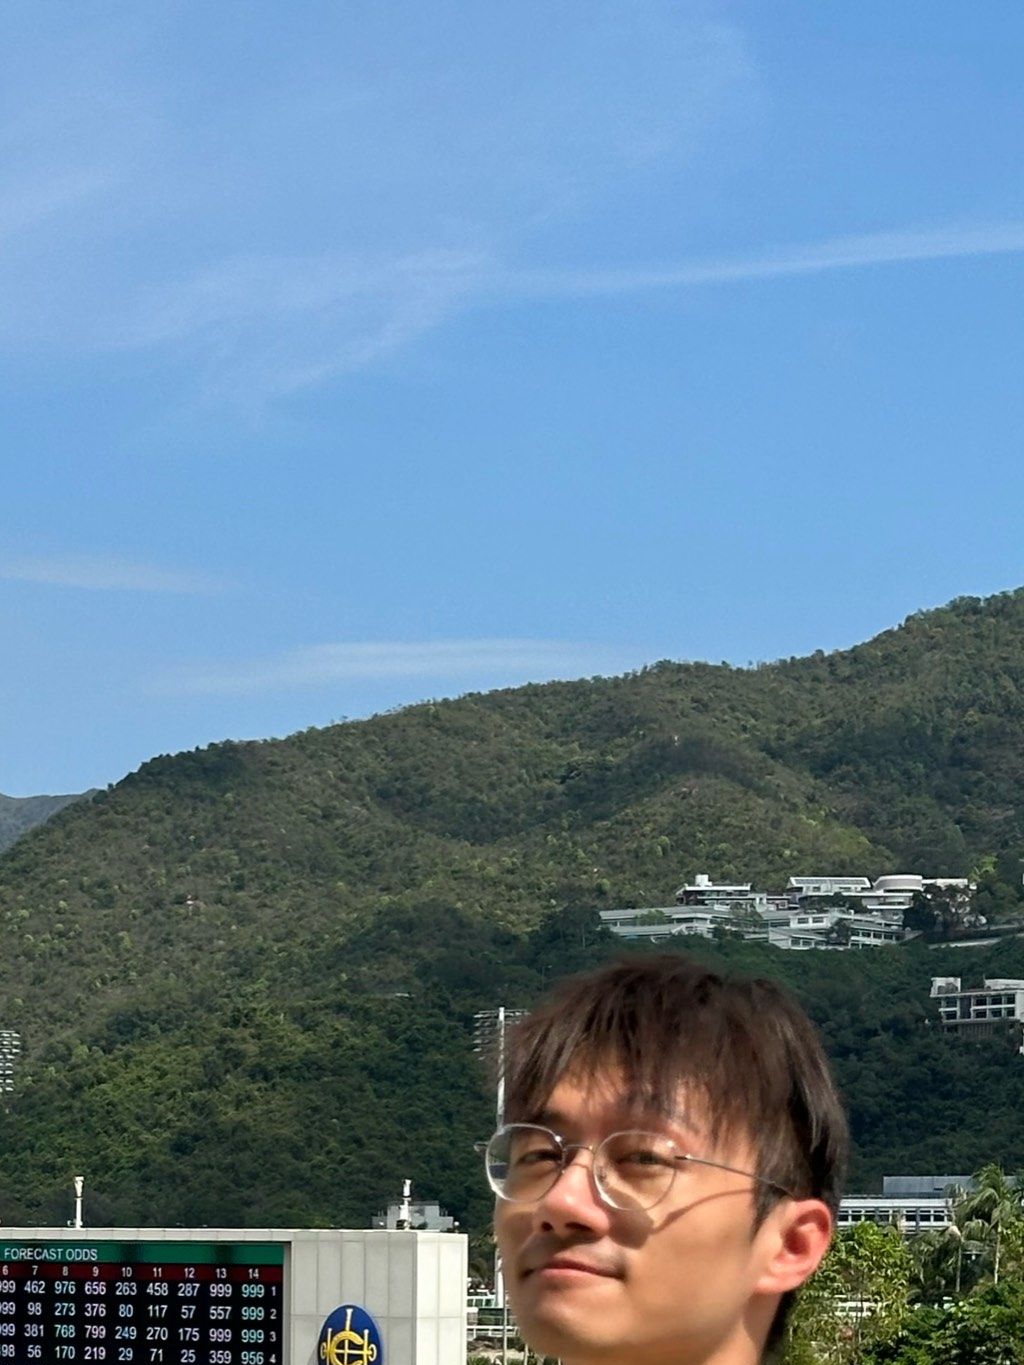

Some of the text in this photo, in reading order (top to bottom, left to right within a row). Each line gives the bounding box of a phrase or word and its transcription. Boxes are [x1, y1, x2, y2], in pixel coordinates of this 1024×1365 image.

[4, 1248, 64, 1260] FORECAST
[66, 1249, 98, 1260] ODDS
[2, 1265, 9, 1275] 6
[32, 1265, 38, 1275] 7
[62, 1266, 68, 1276] 8
[92, 1266, 99, 1277] 9
[122, 1267, 132, 1277] 10
[153, 1267, 162, 1277] 11
[184, 1267, 195, 1278] 12
[216, 1268, 227, 1279] 13
[248, 1268, 259, 1279] 14
[24, 1280, 45, 1294] 462
[54, 1281, 76, 1294] 976
[84, 1281, 106, 1295] 656
[115, 1282, 137, 1295] 263
[146, 1282, 169, 1296] 458
[177, 1283, 200, 1297] 287
[209, 1283, 232, 1297] 999
[241, 1284, 265, 1298] 999
[271, 1286, 276, 1296] 1
[27, 1302, 42, 1315] 98
[54, 1302, 76, 1316] 273
[84, 1303, 106, 1317] 376
[118, 1304, 134, 1318] 80
[148, 1305, 168, 1318] 117
[181, 1305, 196, 1319] 57
[209, 1306, 232, 1320] 557
[241, 1306, 264, 1321] 999
[270, 1308, 276, 1319] 2
[24, 1323, 44, 1337] 381
[54, 1324, 76, 1338] 768
[84, 1325, 106, 1339] 799
[115, 1326, 137, 1340] 249
[146, 1327, 168, 1341] 270
[178, 1327, 200, 1341] 175
[209, 1328, 232, 1342] 999
[241, 1329, 264, 1343] 999
[270, 1331, 276, 1342] 3
